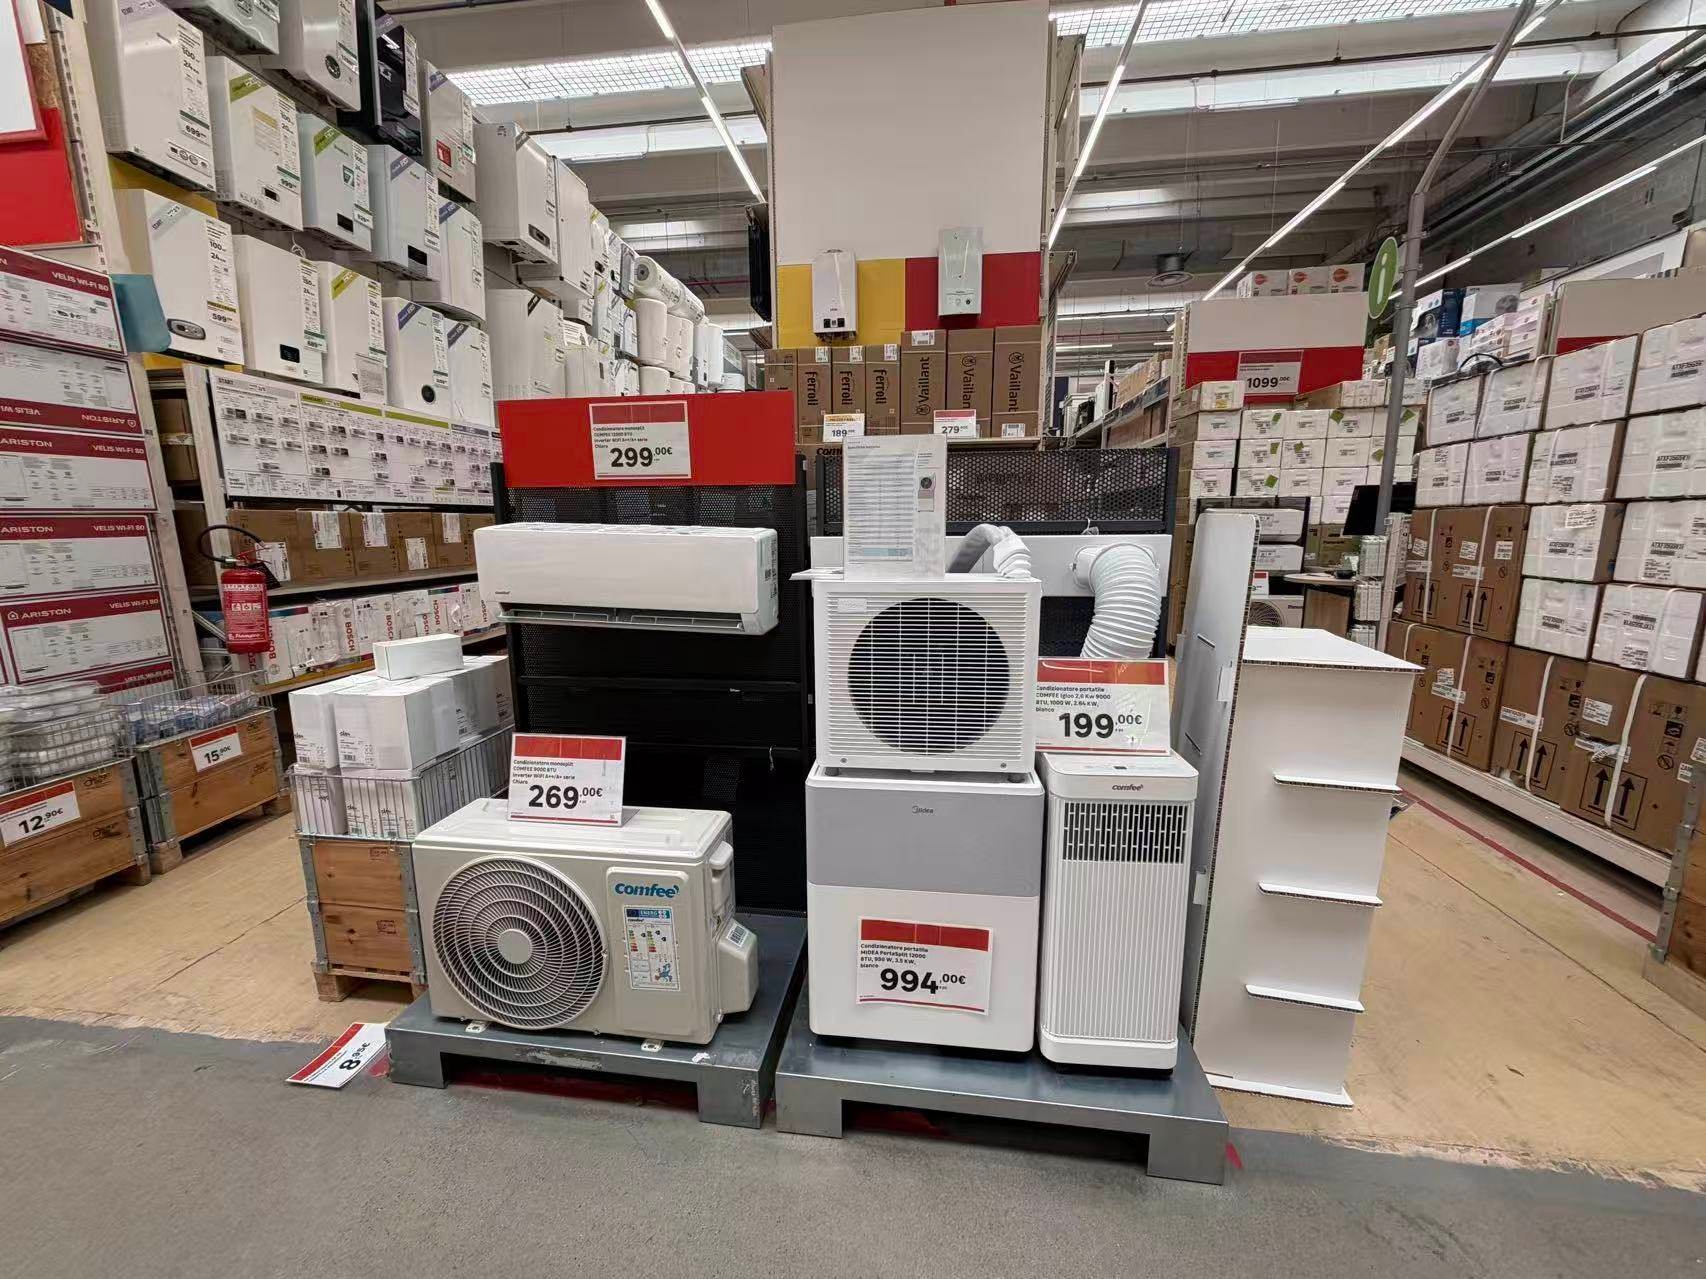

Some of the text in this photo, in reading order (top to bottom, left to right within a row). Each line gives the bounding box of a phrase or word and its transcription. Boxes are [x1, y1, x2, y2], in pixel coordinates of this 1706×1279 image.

[52, 271, 77, 283] VELIS
[77, 278, 97, 290] WI-FI
[918, 357, 930, 403] Vaillant
[805, 371, 818, 406] Ferroli
[840, 370, 853, 406] Ferroli
[873, 369, 887, 405] Ferroli
[962, 368, 975, 409] Vaillan
[15, 406, 41, 416] VELIS
[81, 414, 125, 424] ARISTON
[1, 438, 53, 448] ARISTON
[92, 444, 114, 452] VELIS
[109, 601, 130, 609] VELIS
[21, 608, 72, 619] ARISTON
[345, 621, 355, 652] BOSCH
[513, 759, 549, 767] Condizionatore
[860, 943, 928, 953] Condizionatore portatile
